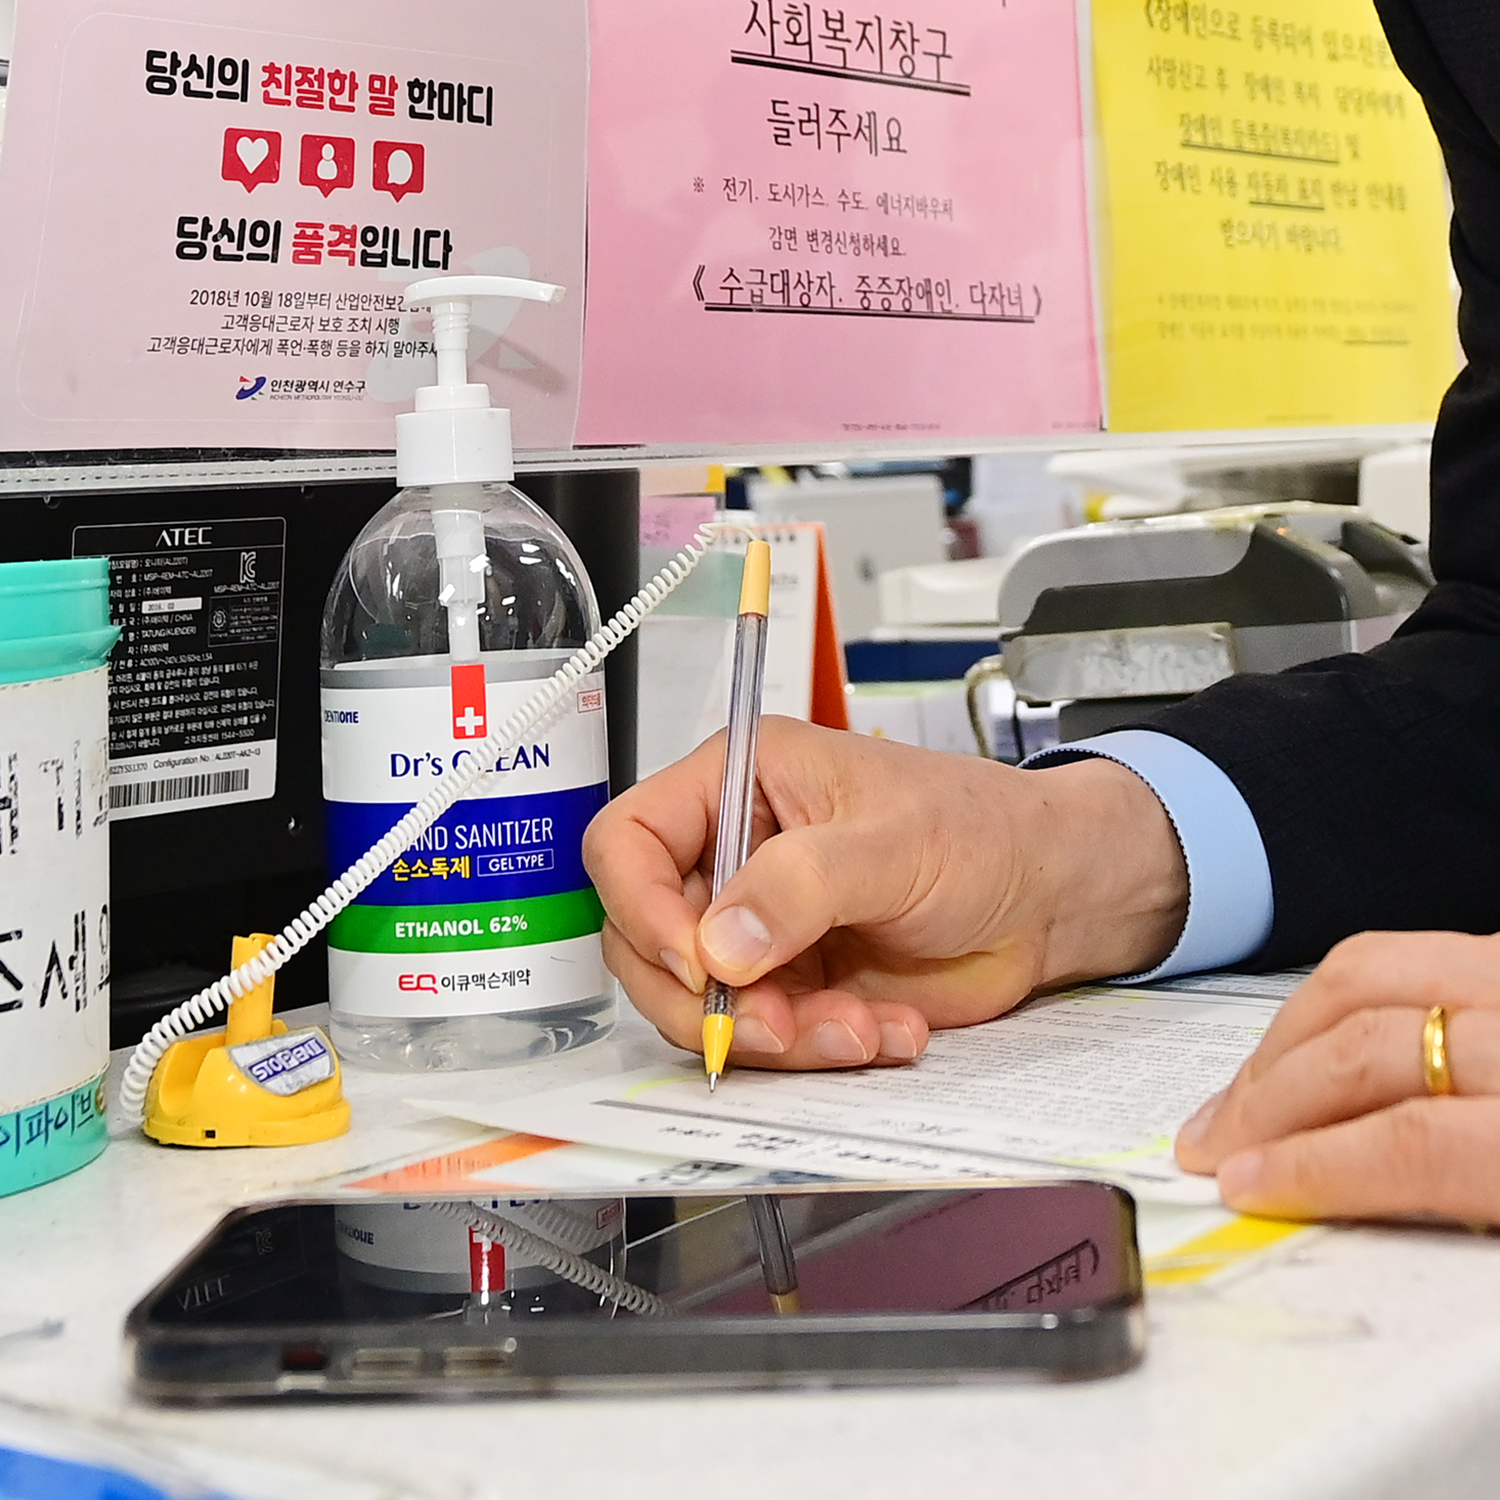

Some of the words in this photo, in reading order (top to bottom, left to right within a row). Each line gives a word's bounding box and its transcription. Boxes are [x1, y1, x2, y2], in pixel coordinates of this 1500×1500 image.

[145, 49, 249, 102] 당신의
[261, 62, 359, 113] 친절한
[368, 74, 398, 116] 말
[407, 78, 493, 126] 한마디
[767, 99, 907, 156] 들러주세요
[175, 216, 281, 263] 당신의
[292, 221, 453, 270] 품격입니다
[769, 225, 798, 252] 감면
[190, 289, 240, 308] 2018년
[244, 290, 273, 309] 10월
[277, 292, 331, 311] 18일부터
[969, 281, 1025, 316] 다자녀
[221, 314, 314, 334] 고객응대근로자
[318, 317, 343, 333] 보호
[347, 317, 371, 335] 조치
[375, 317, 400, 336] 시행
[147, 336, 272, 356] 고객응대근로자에게
[336, 340, 361, 358] 등을
[365, 340, 389, 358] 하지
[270, 379, 329, 393] 인천광역시
[333, 380, 366, 393] 연수구
[155, 527, 213, 547] ATEC
[390, 751, 444, 778] Dr's
[405, 826, 448, 852] AND
[454, 817, 553, 849] SANITIZER
[392, 855, 471, 882] 손소독제
[488, 856, 515, 872] GEL
[515, 853, 544, 869] TYPE
[395, 919, 484, 938] ETHANOL
[489, 914, 528, 933] 62%
[441, 967, 531, 992] 이큐맥슨제약
